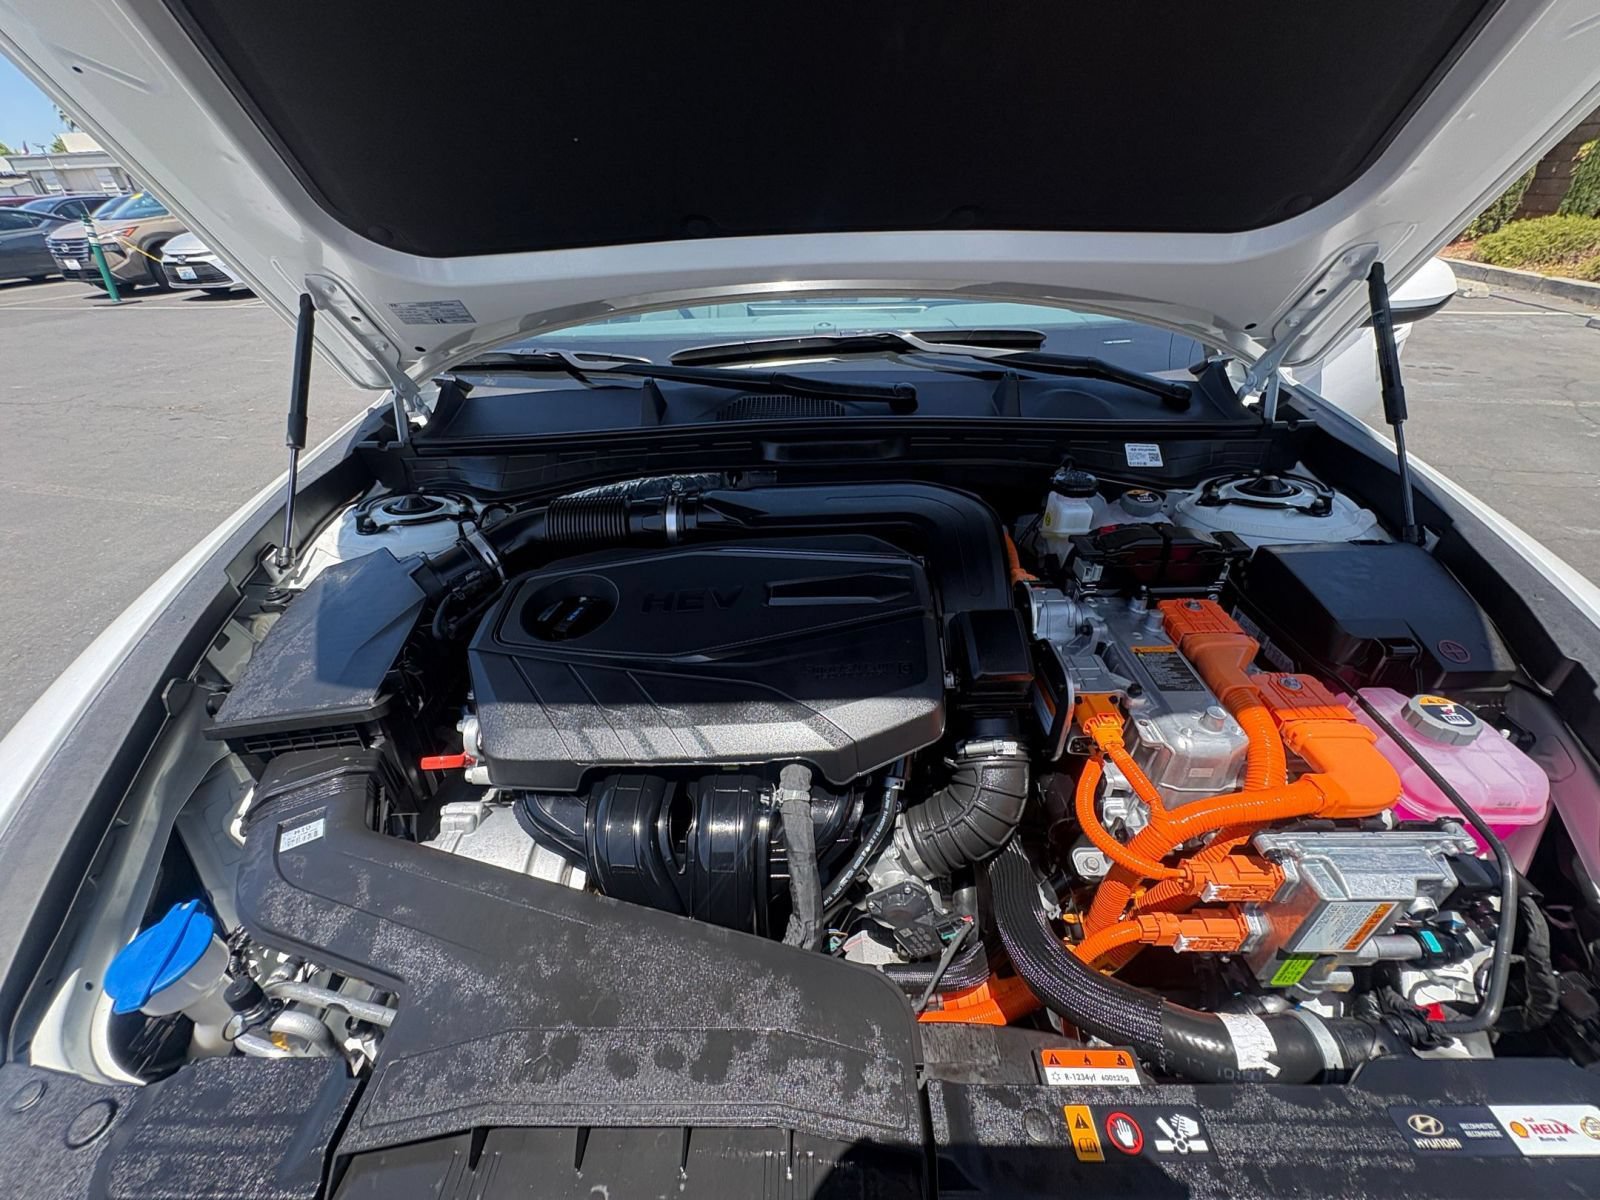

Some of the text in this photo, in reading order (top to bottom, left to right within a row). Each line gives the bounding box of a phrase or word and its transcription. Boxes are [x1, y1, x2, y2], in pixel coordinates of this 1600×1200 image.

[640, 587, 744, 614] HEV
[1527, 1123, 1577, 1135] HELIX
[1412, 1138, 1463, 1149] HYUNDAI
